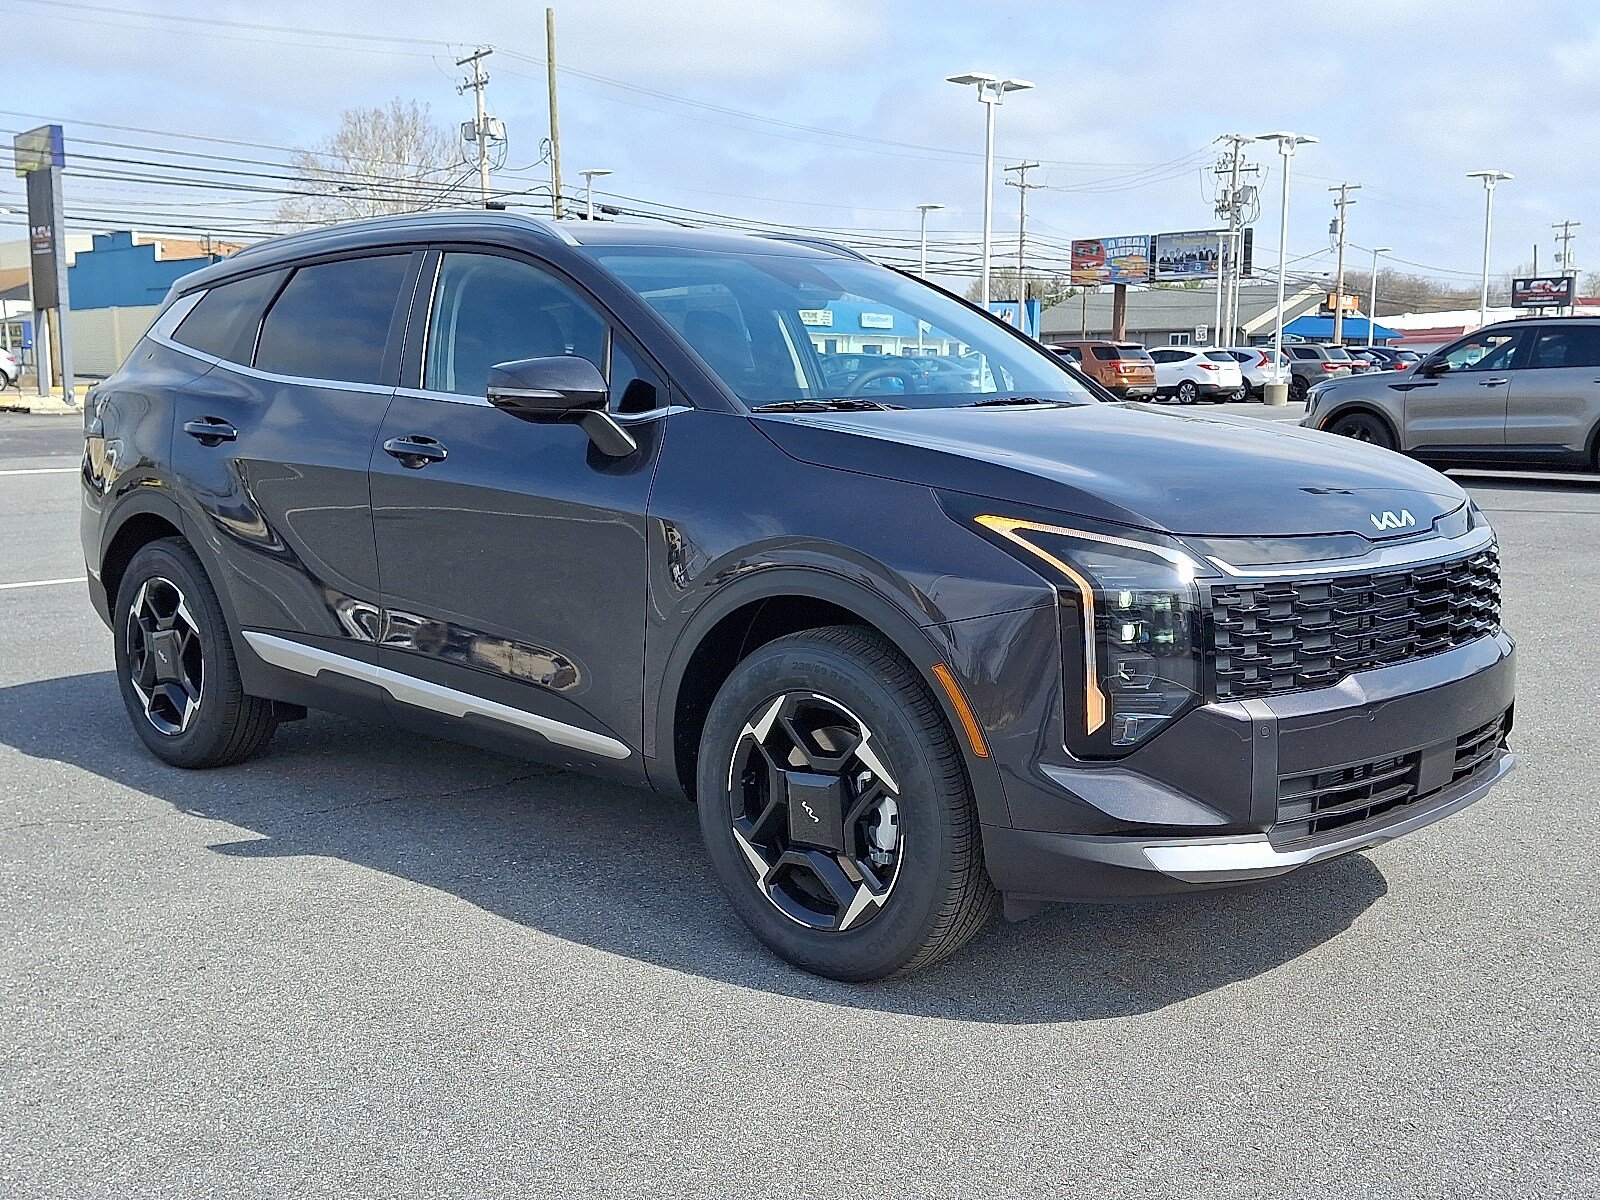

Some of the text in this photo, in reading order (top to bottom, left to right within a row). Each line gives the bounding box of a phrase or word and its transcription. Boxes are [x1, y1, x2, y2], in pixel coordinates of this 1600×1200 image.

[1118, 237, 1146, 248] REAL
[1106, 246, 1147, 259] KEEPER
[1196, 332, 1206, 340] 35
[1369, 508, 1416, 531] KIA
